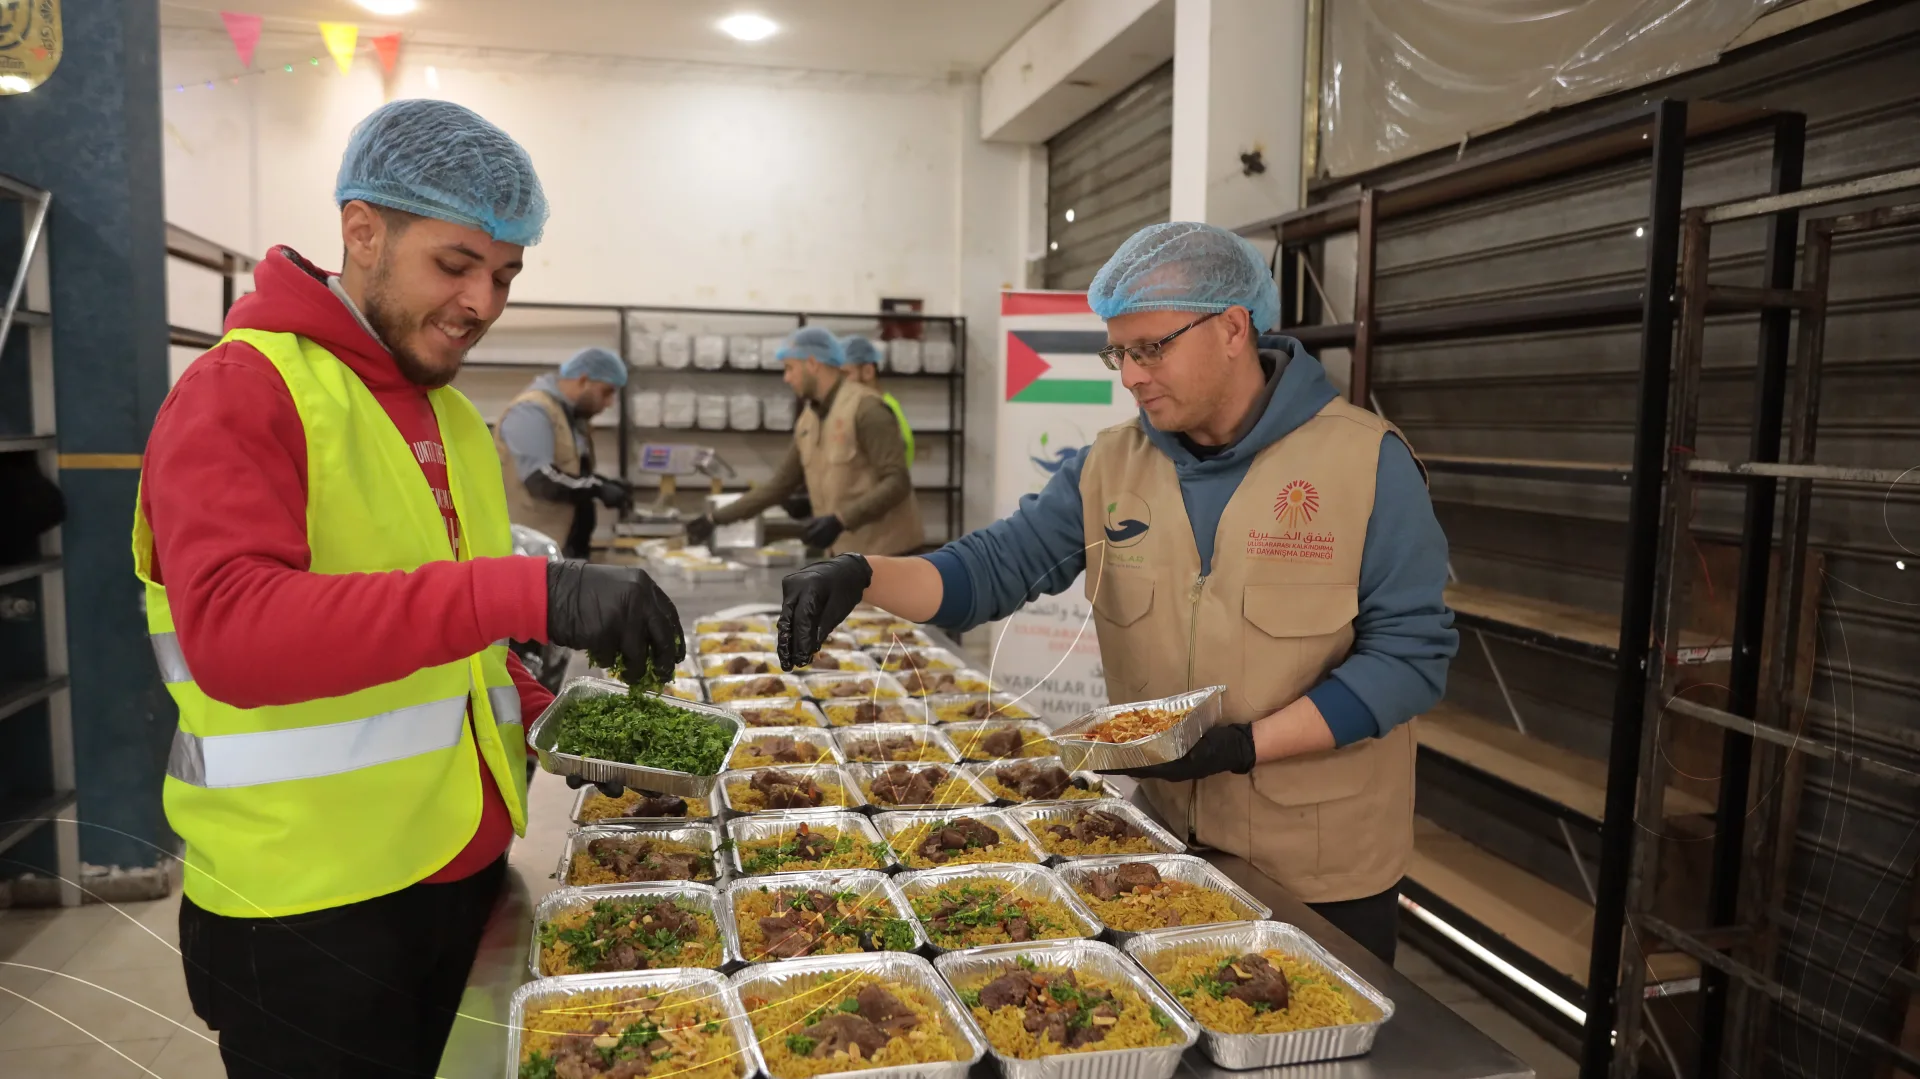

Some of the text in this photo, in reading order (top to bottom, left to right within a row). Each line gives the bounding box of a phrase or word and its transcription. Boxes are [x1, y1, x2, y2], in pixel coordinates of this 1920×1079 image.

[1303, 531, 1335, 544] شفق
[1246, 547, 1256, 555] VE
[1256, 548, 1298, 558] DAYANIŞMA
